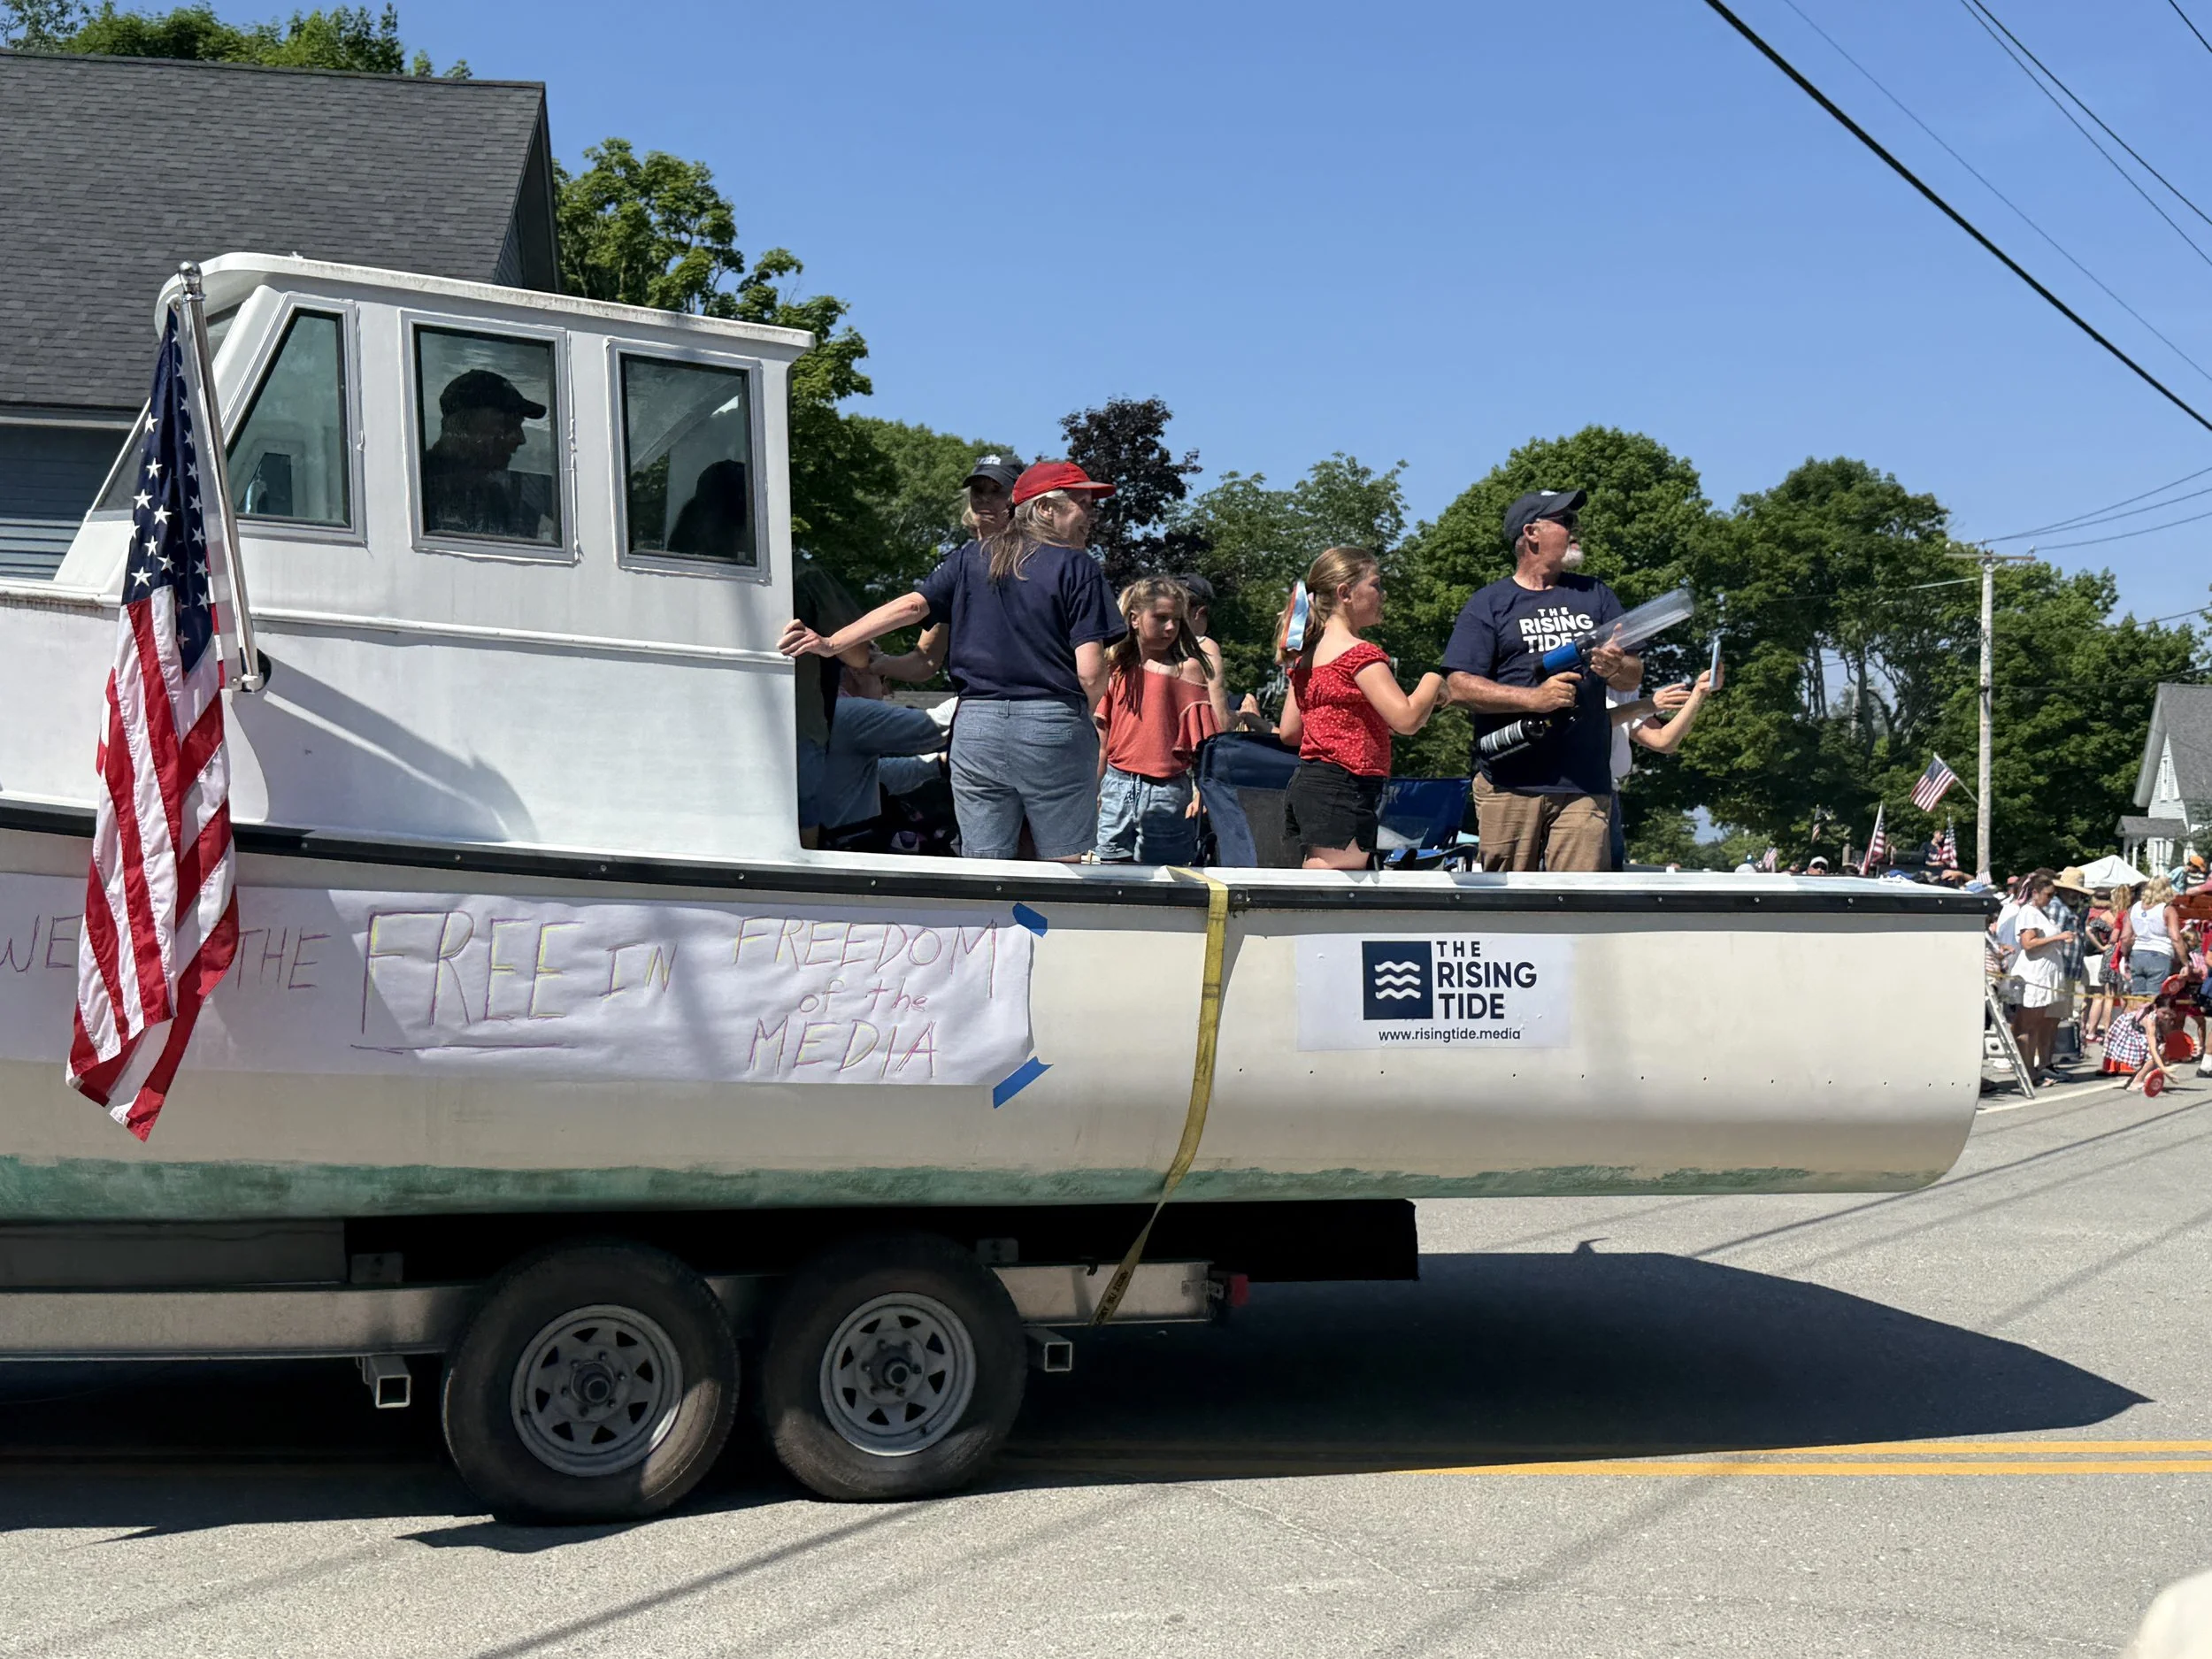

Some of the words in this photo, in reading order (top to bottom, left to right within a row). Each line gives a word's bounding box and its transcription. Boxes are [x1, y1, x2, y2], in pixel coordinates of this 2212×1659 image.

[1518, 613, 1594, 634] RISING
[1537, 606, 1569, 618] THE
[733, 915, 997, 998] FREEDOM
[1436, 941, 1481, 957] THE
[237, 928, 331, 990] THE
[361, 910, 586, 1033] FREE
[599, 942, 678, 1001] IN
[1437, 961, 1537, 988] RISING
[799, 978, 844, 1013] of
[865, 976, 928, 1012] the
[1438, 993, 1506, 1019] TIDE
[749, 1015, 938, 1078] MEDIA
[1379, 1027, 1521, 1043] www.risingtide.media
